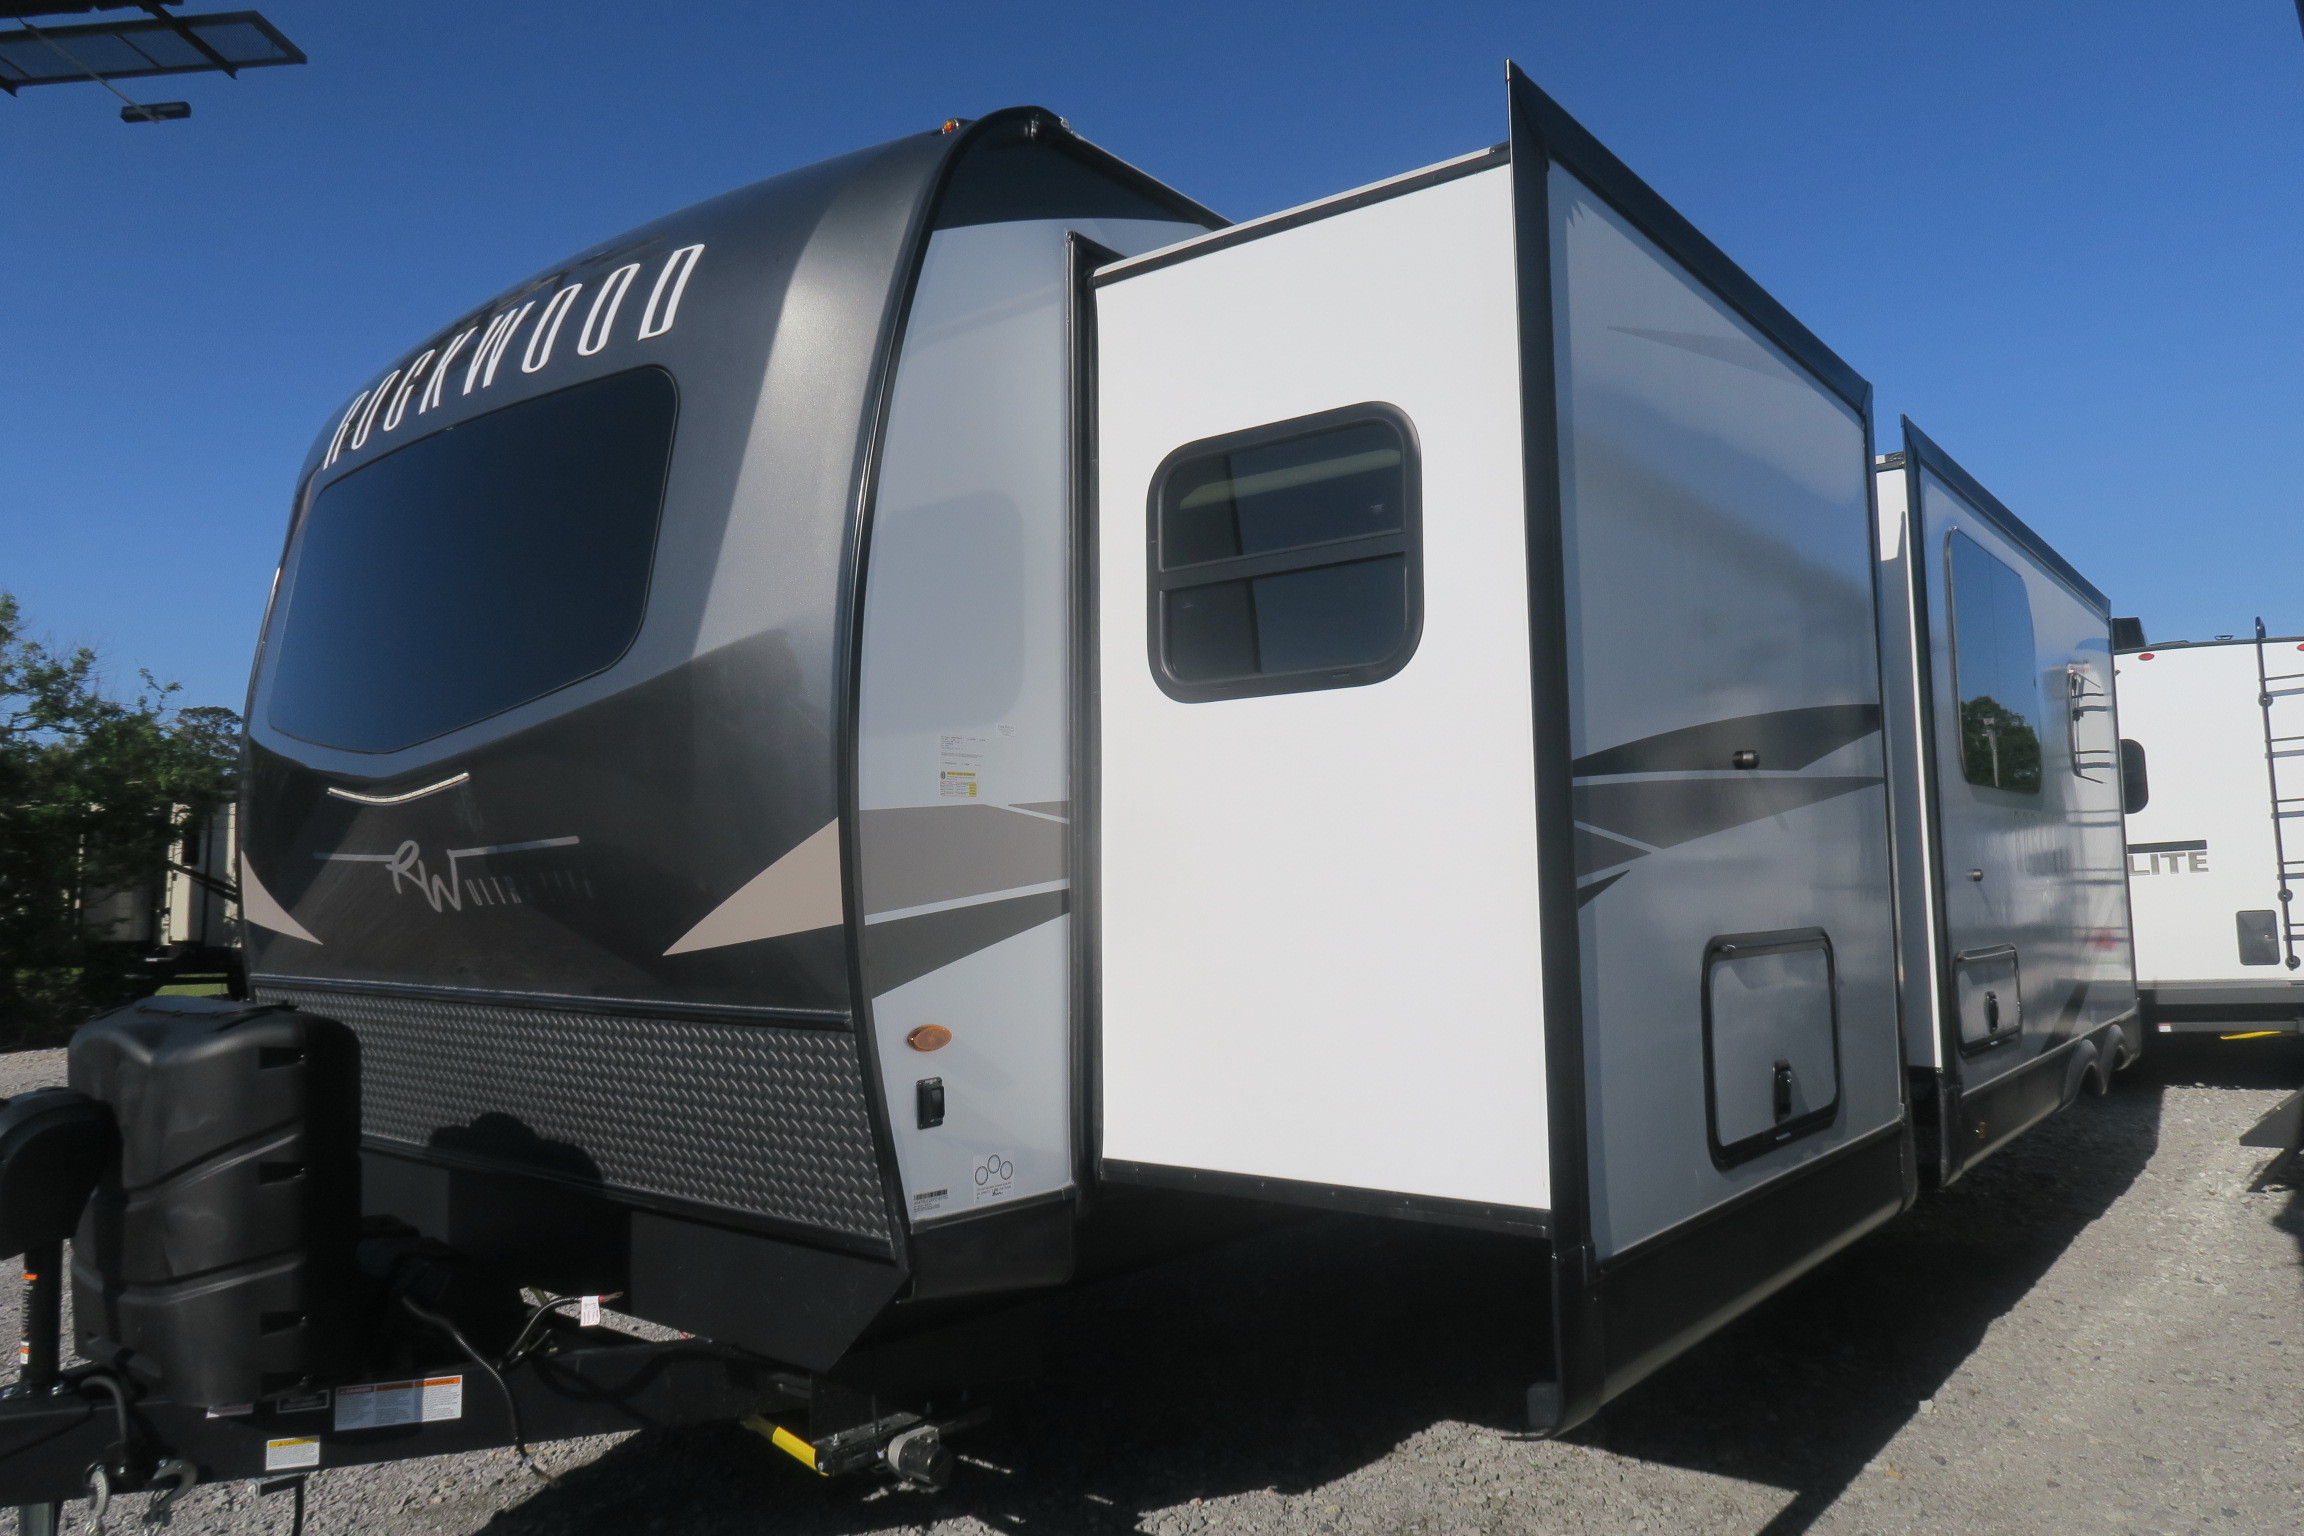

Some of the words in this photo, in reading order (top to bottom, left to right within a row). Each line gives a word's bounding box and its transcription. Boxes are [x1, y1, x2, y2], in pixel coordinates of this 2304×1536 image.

[324, 244, 705, 470] ROCKWOOD
[2128, 852, 2208, 876] LITE
[464, 876, 530, 906] ULTR
